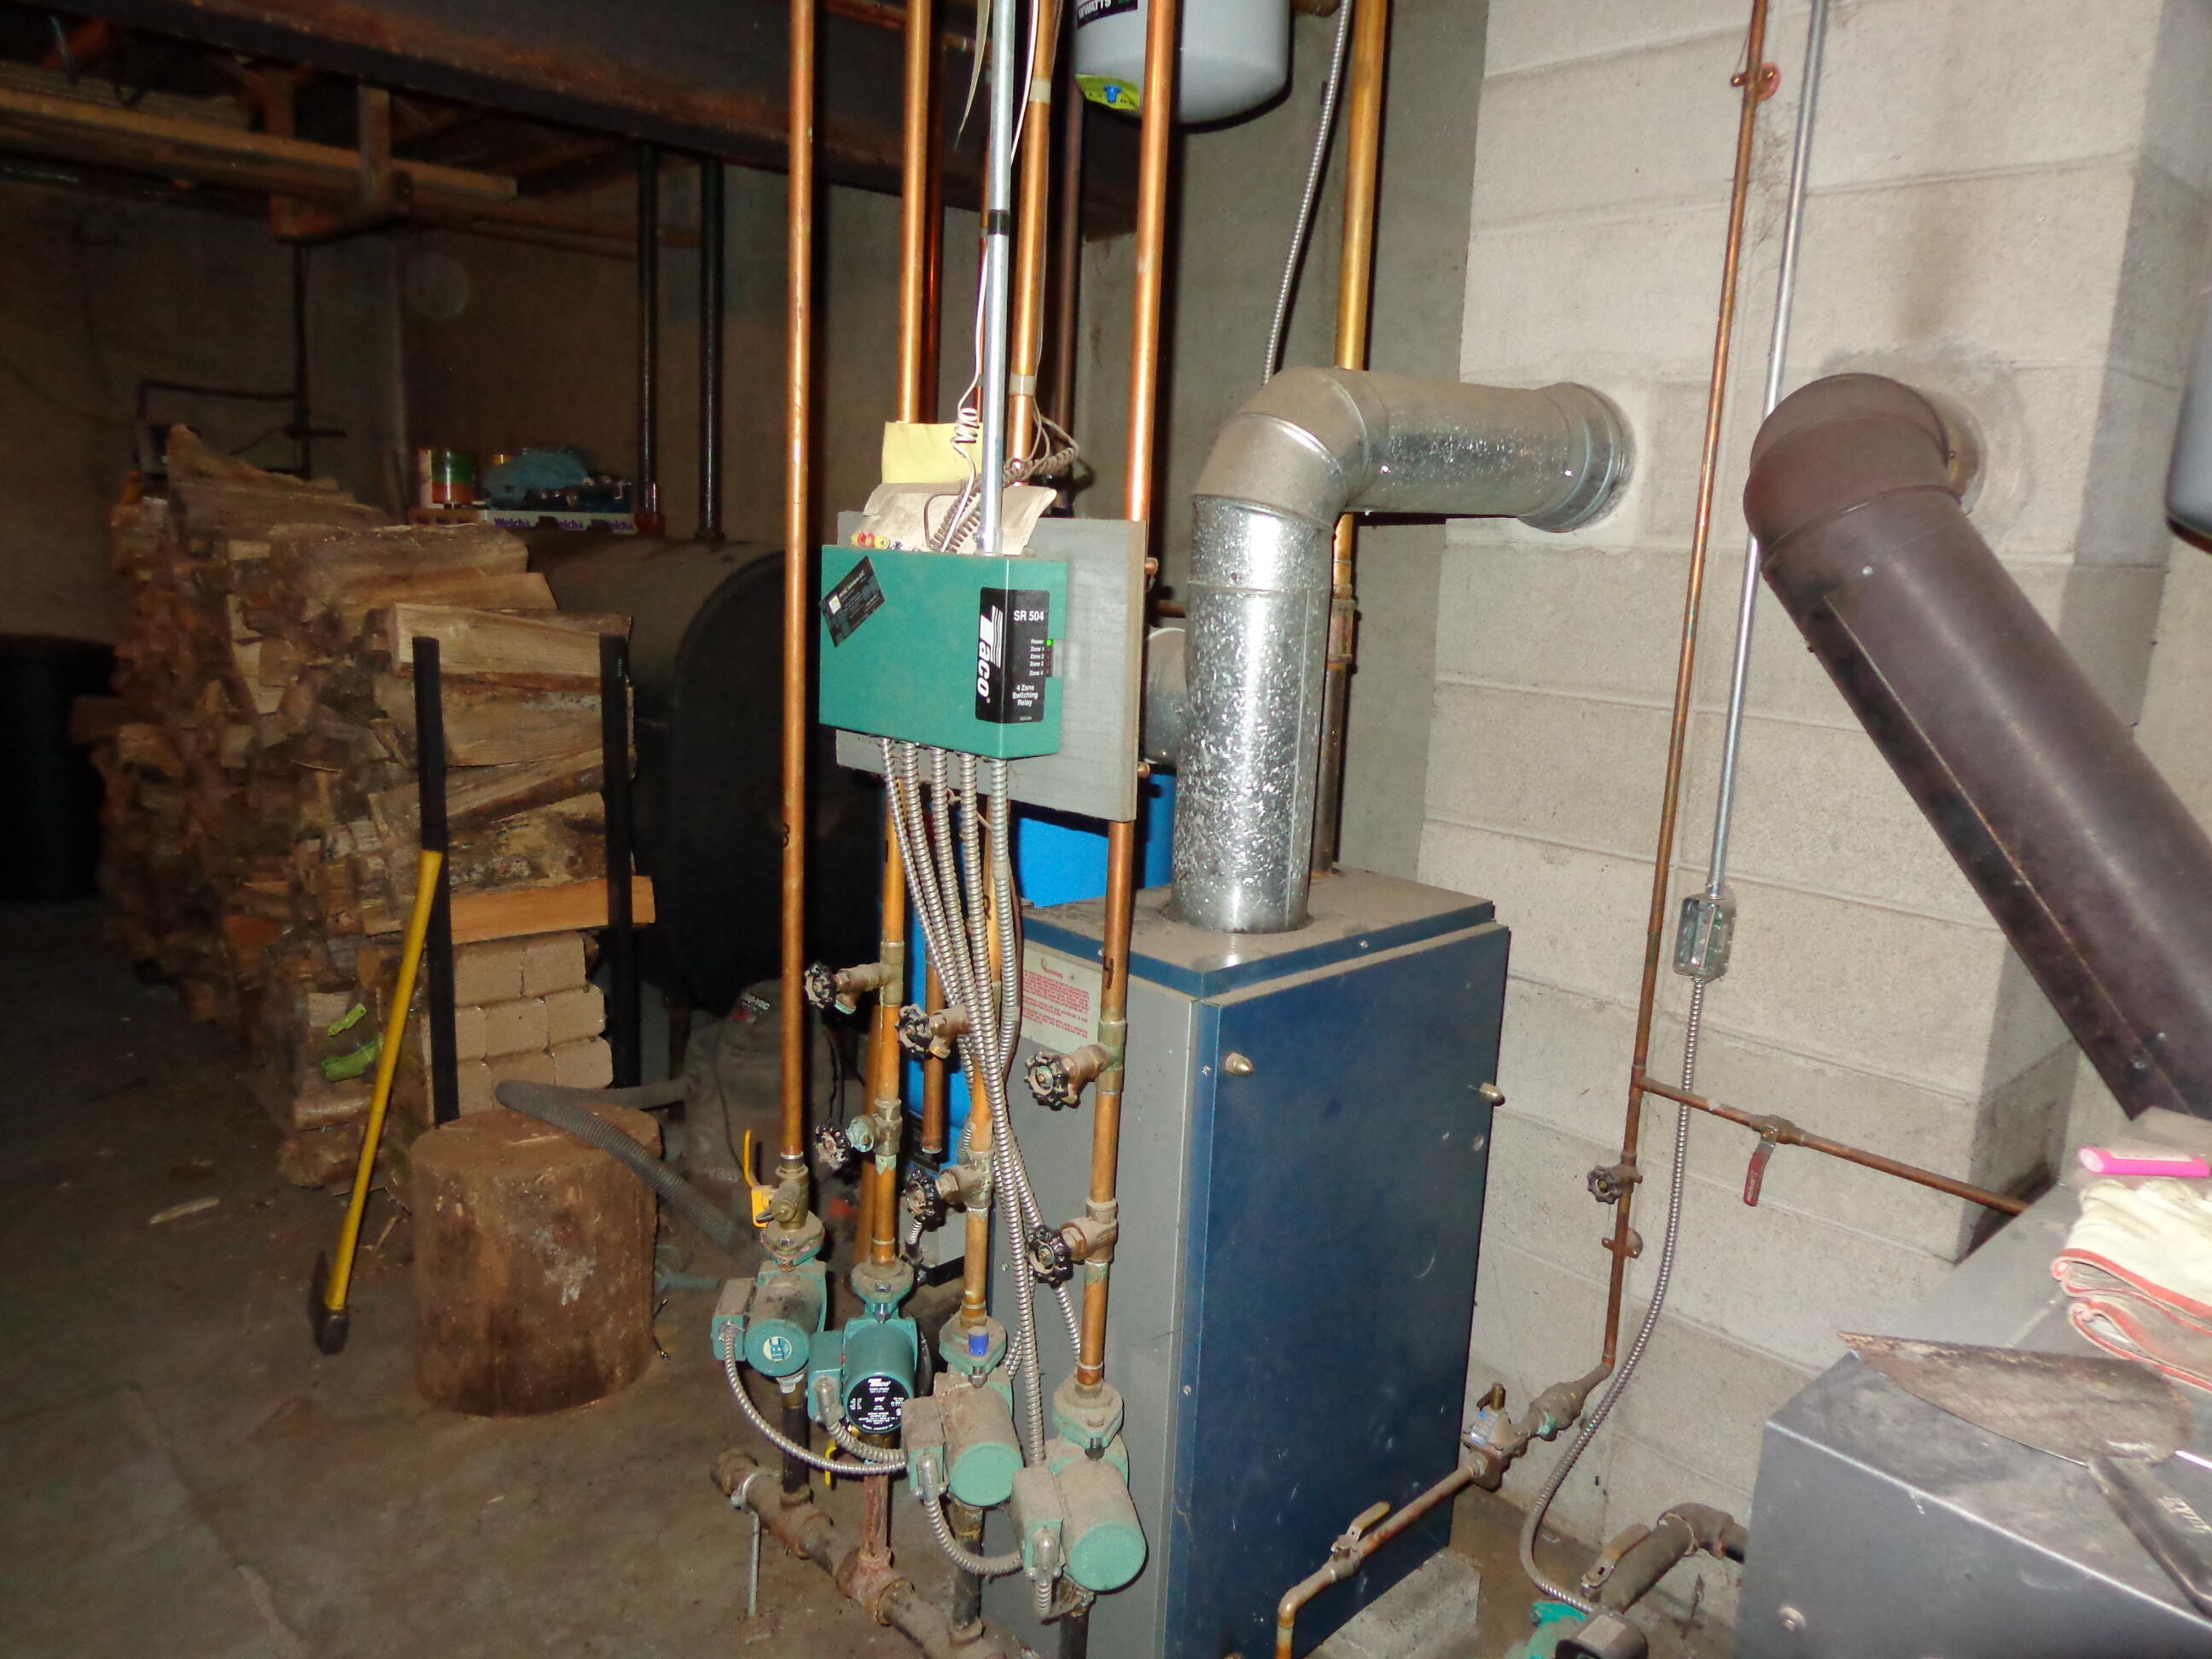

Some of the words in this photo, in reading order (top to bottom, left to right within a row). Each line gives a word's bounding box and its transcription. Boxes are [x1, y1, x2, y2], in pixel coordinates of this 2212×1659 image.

[1014, 609, 1027, 621] SR
[1028, 610, 1044, 621] 504
[1012, 691, 1039, 700] Switching
[1017, 699, 1033, 707] Relay
